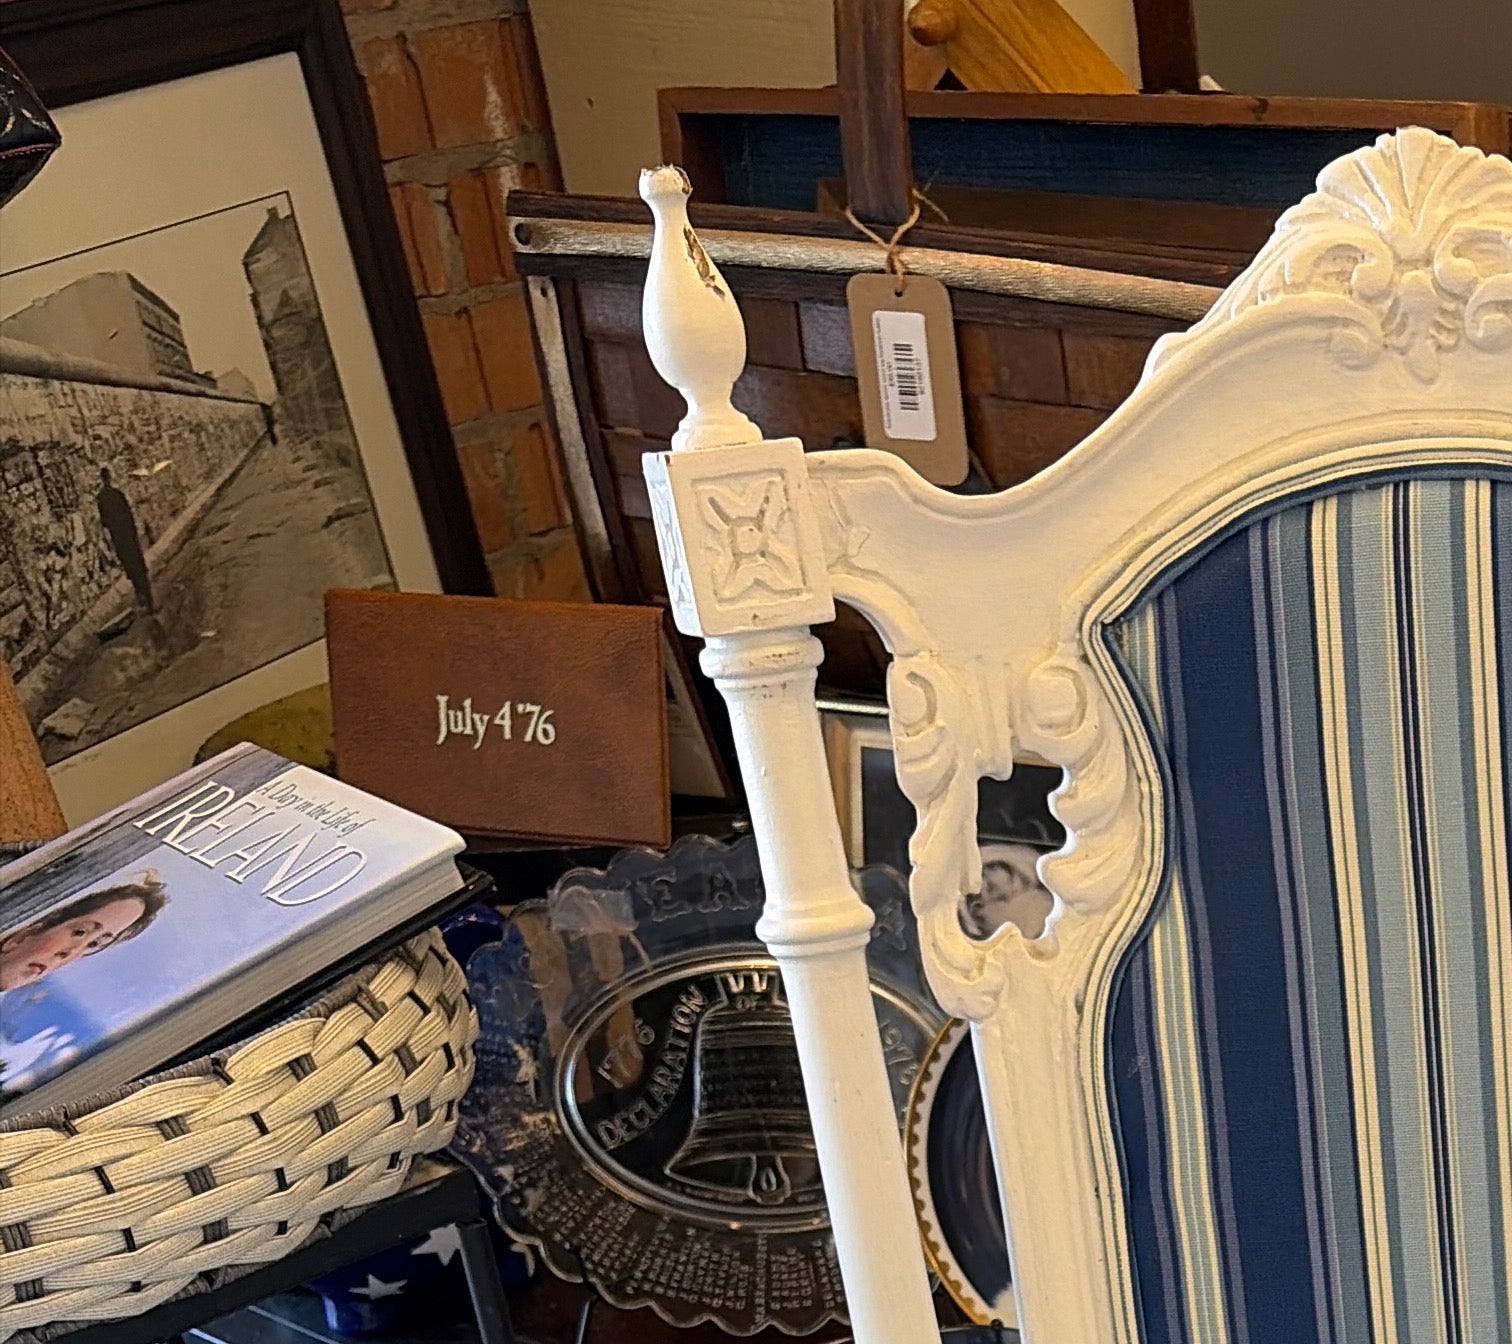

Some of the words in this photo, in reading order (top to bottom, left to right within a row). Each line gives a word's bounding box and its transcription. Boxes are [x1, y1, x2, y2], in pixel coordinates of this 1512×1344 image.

[436, 694, 490, 750] July
[494, 700, 511, 740] 4
[516, 702, 556, 745] '76
[256, 780, 283, 796] A
[268, 783, 304, 810] Day
[294, 796, 316, 813] in
[306, 800, 335, 821] the
[320, 806, 360, 831] Life
[336, 818, 376, 838] of
[133, 780, 367, 906] IRELAND
[597, 984, 707, 1150] DECLARATION
